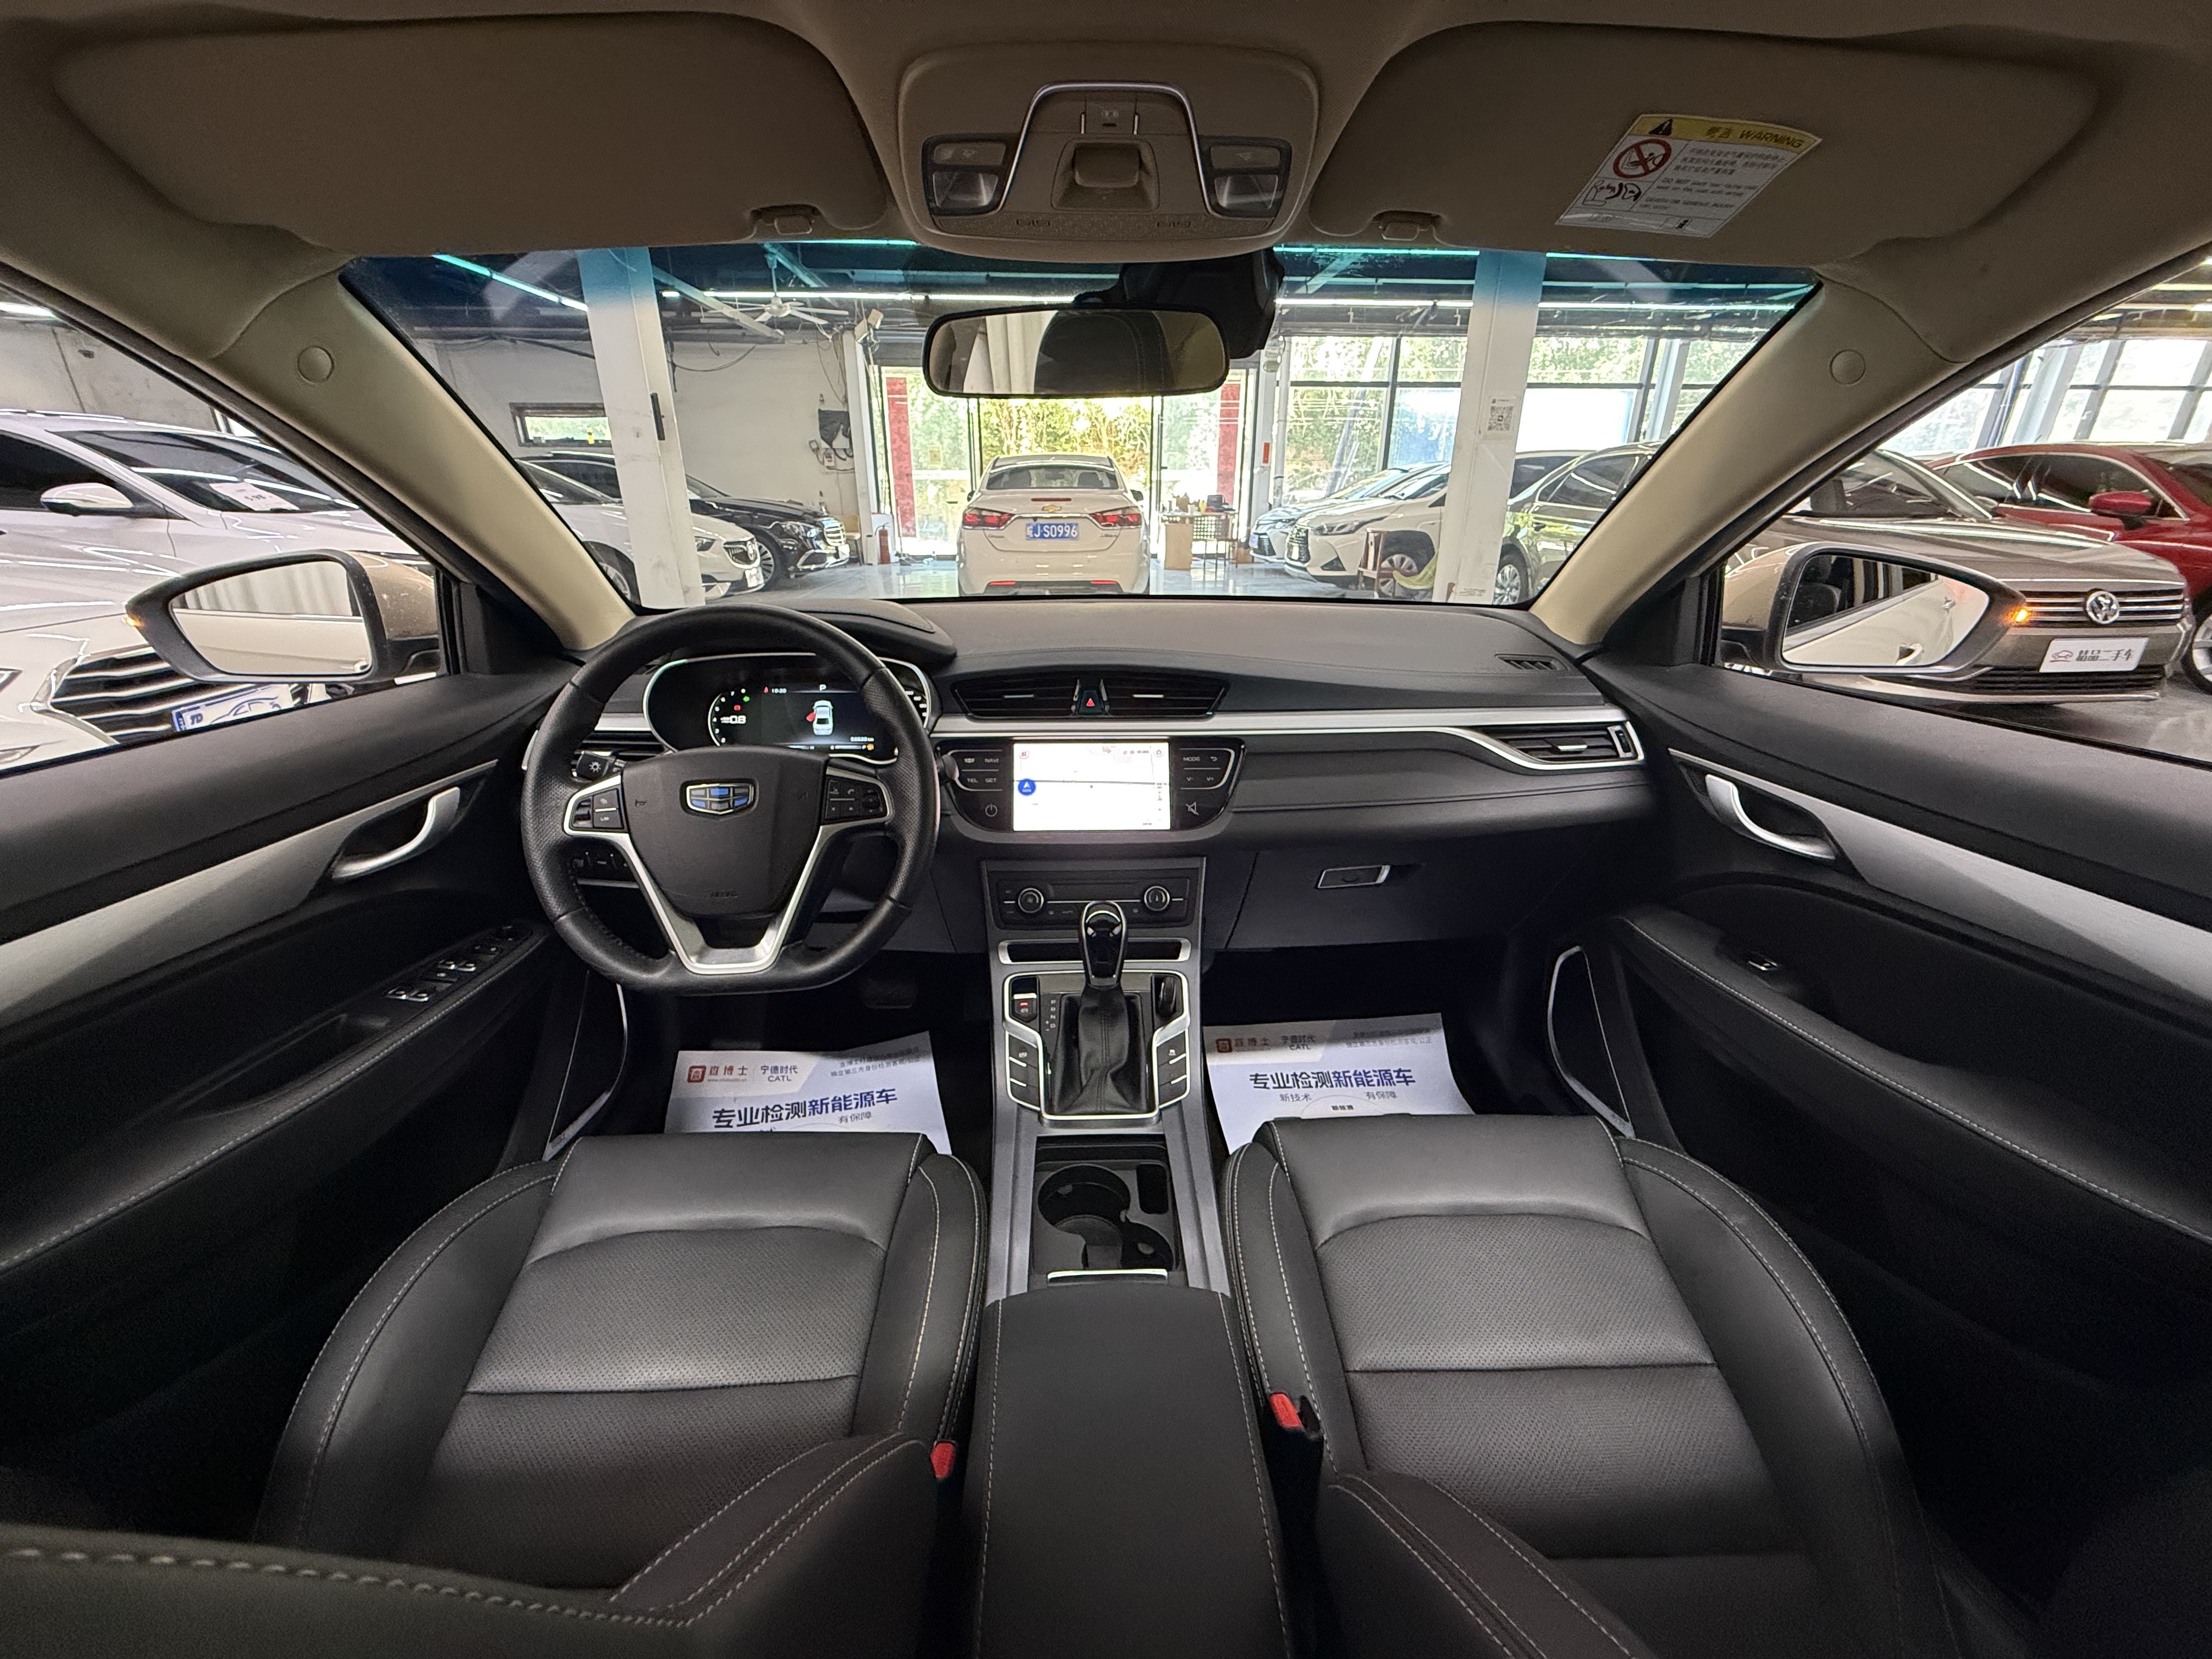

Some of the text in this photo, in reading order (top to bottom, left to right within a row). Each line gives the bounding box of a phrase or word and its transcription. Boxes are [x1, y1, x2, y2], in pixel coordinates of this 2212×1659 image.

[1739, 129, 1805, 149] WARNING
[760, 1065, 798, 1075] 宁德时代
[1249, 1068, 1416, 1090] 专业检测新能源车
[1279, 1093, 1312, 1102] 新技术
[1364, 1090, 1397, 1100] 有保障
[712, 1087, 898, 1129] 专业检测新能源车
[838, 1110, 873, 1125] 有保障
